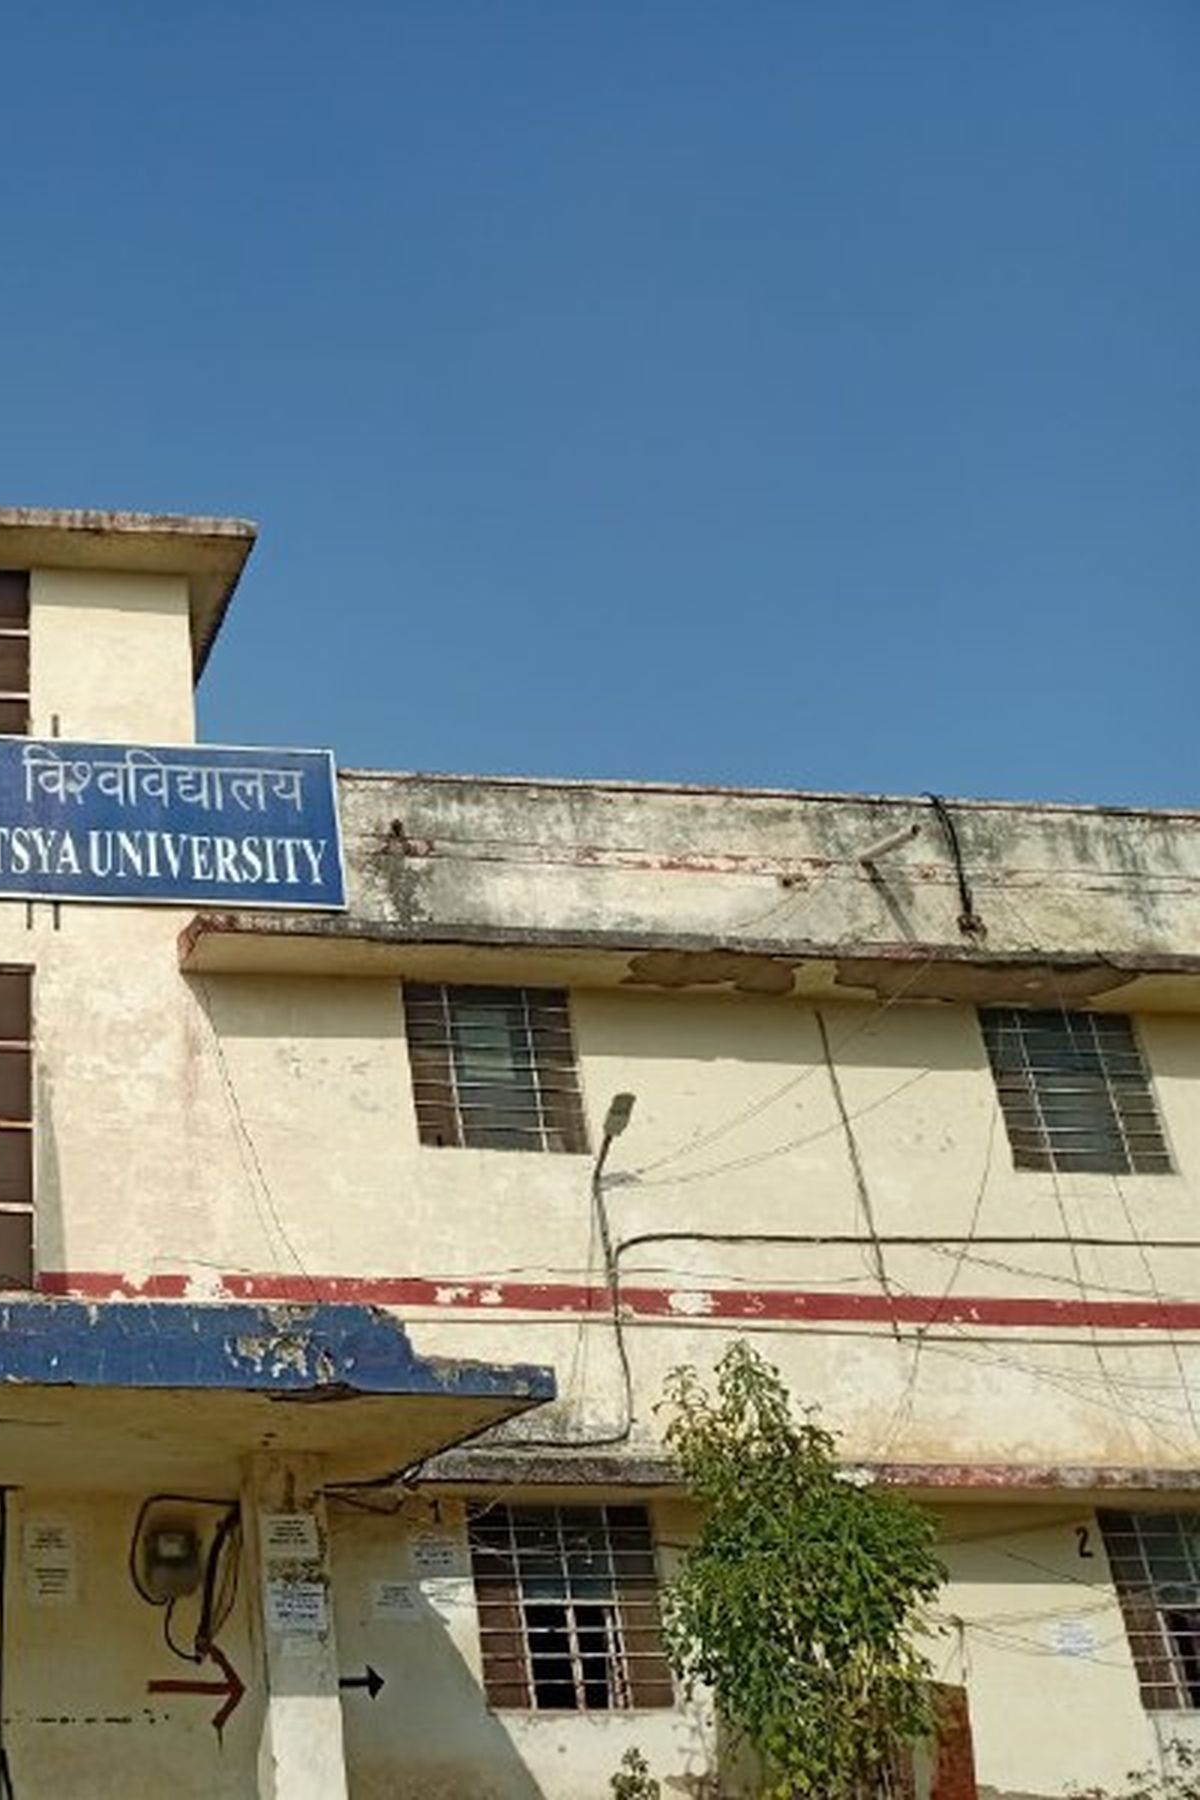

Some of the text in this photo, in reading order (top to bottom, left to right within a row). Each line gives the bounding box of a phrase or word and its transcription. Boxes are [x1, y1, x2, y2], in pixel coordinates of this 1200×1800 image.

[22, 744, 304, 812] विश्वविद्यालय
[89, 826, 327, 886] UNIVERSITY
[429, 1499, 442, 1523] 1
[1075, 1526, 1094, 1558] 2
